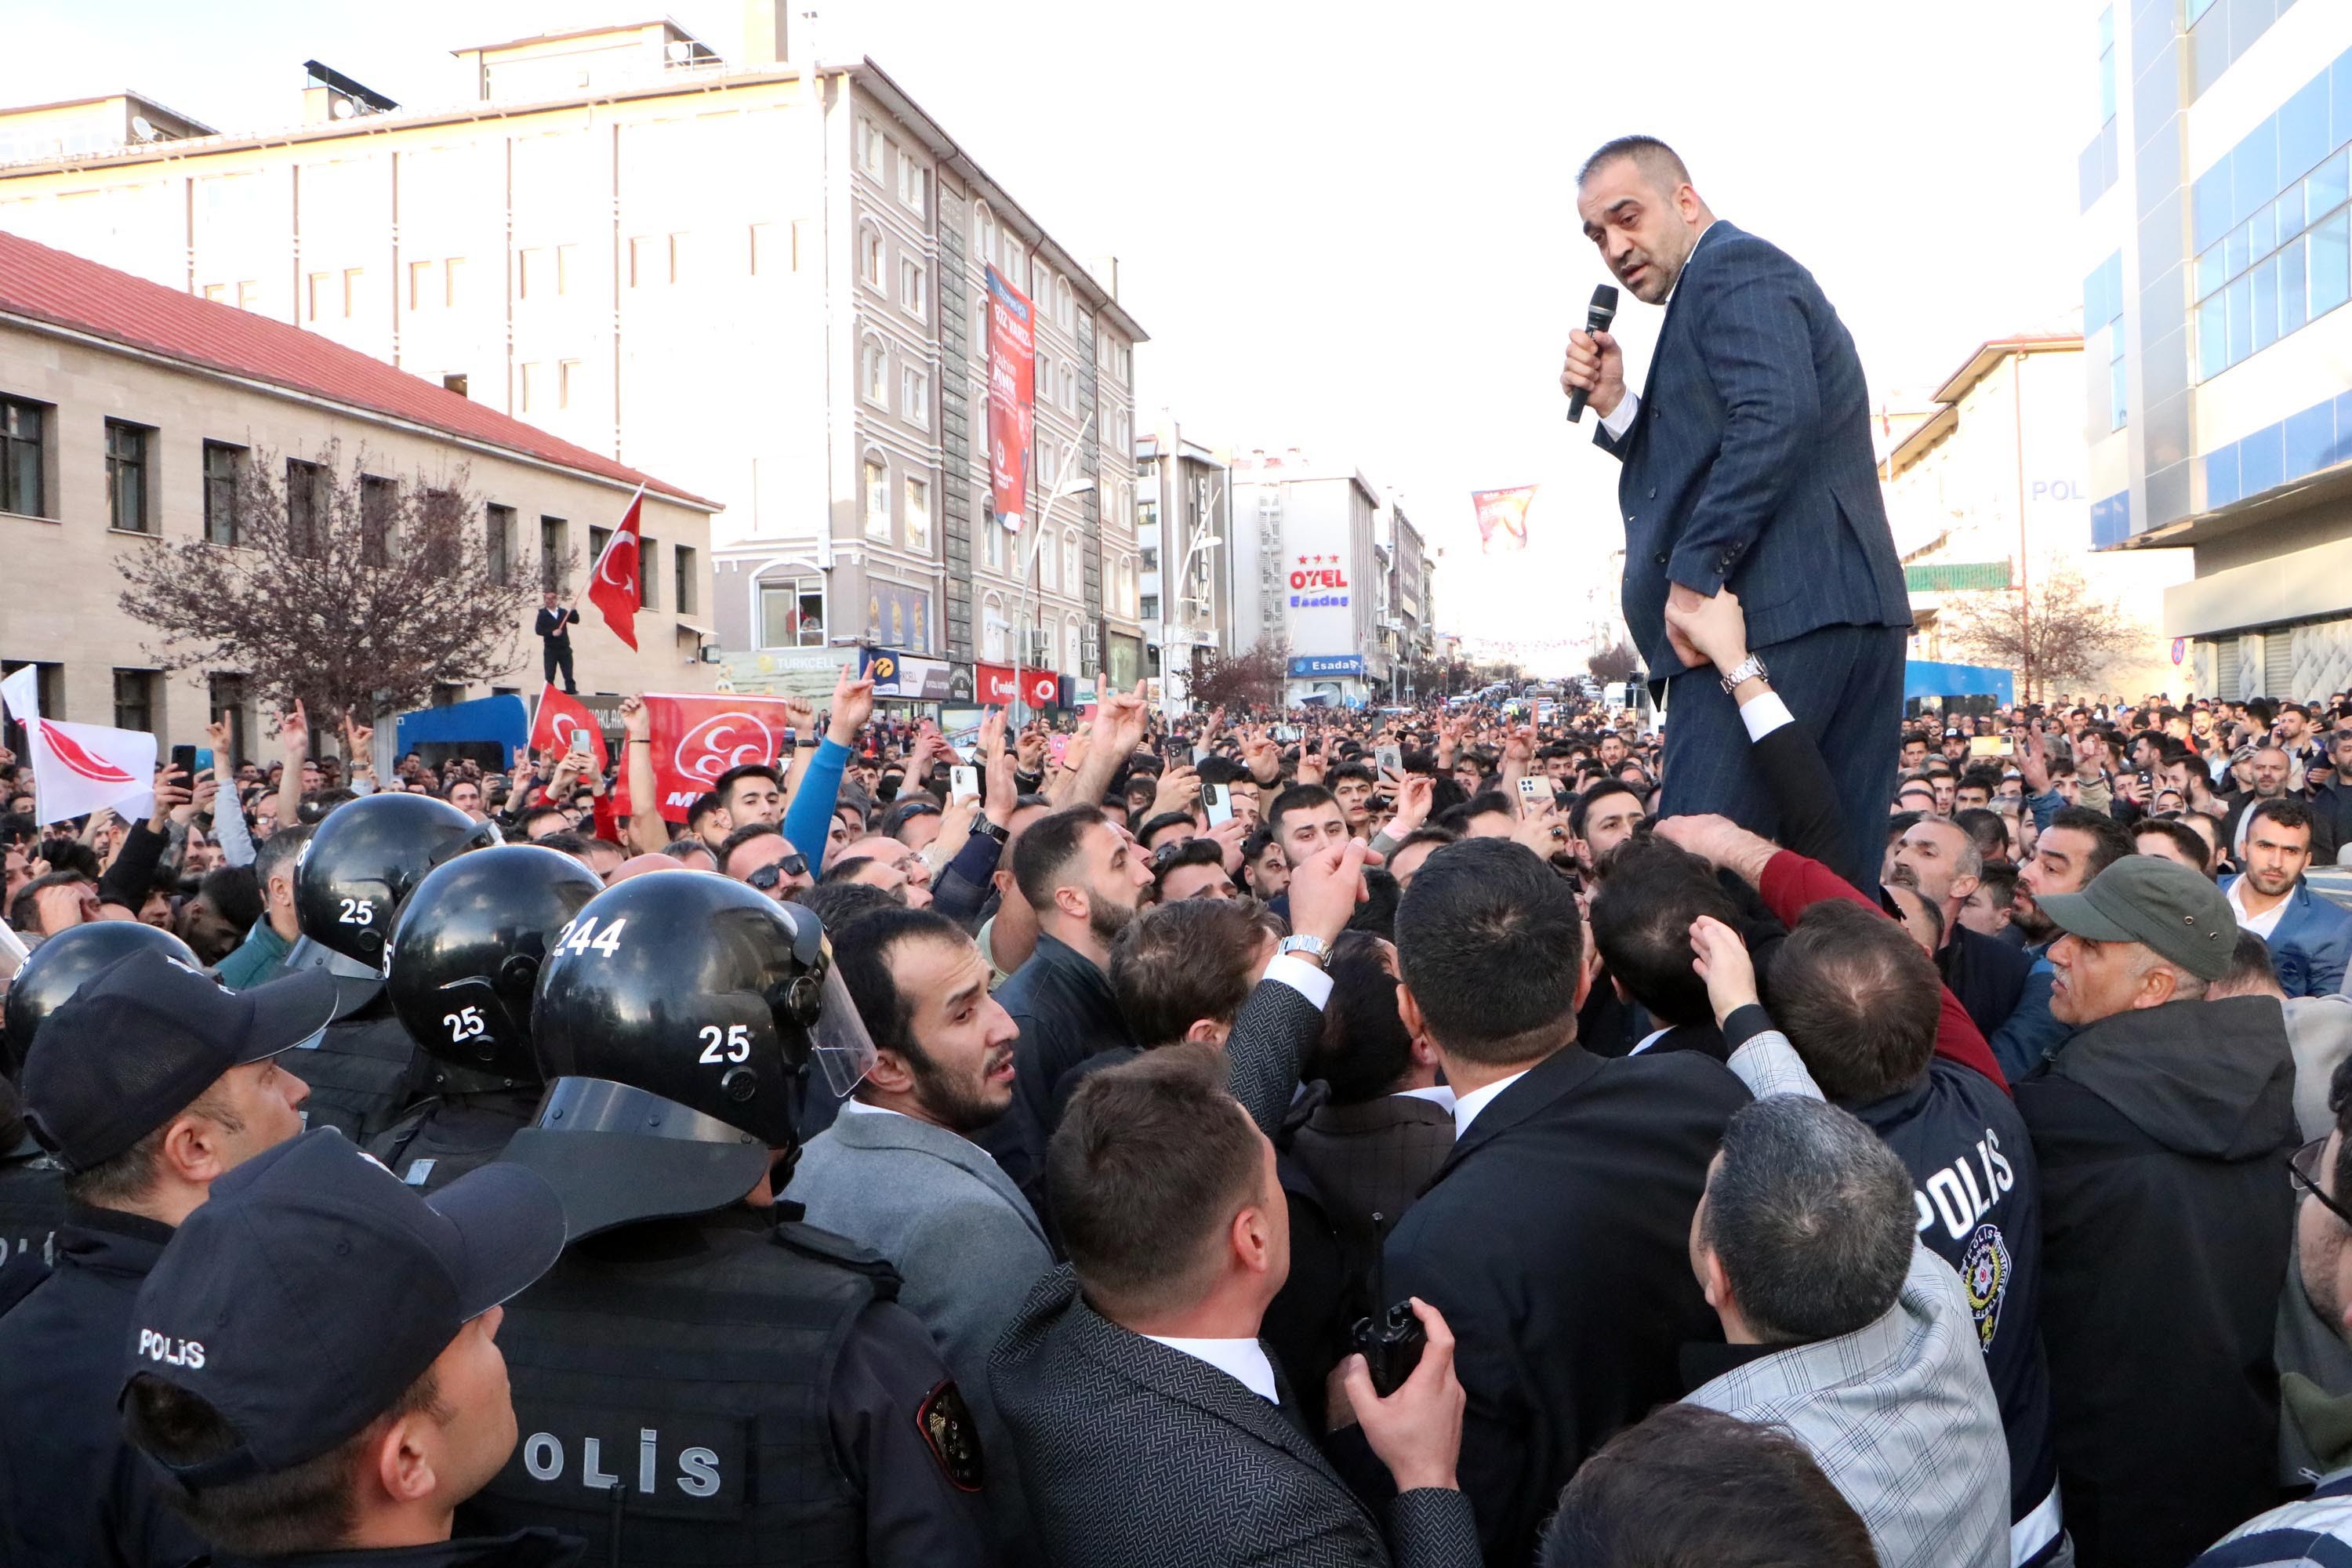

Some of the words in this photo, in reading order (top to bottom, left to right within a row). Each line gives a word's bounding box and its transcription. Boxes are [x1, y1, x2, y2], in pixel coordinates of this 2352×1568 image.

[1290, 569, 1348, 589] OTEL
[339, 898, 373, 925] 25
[553, 916, 627, 958] 244
[444, 1006, 485, 1042] 25
[699, 1025, 750, 1064] 25
[139, 1329, 205, 1370] POLİS
[524, 1427, 720, 1497] OLİS
